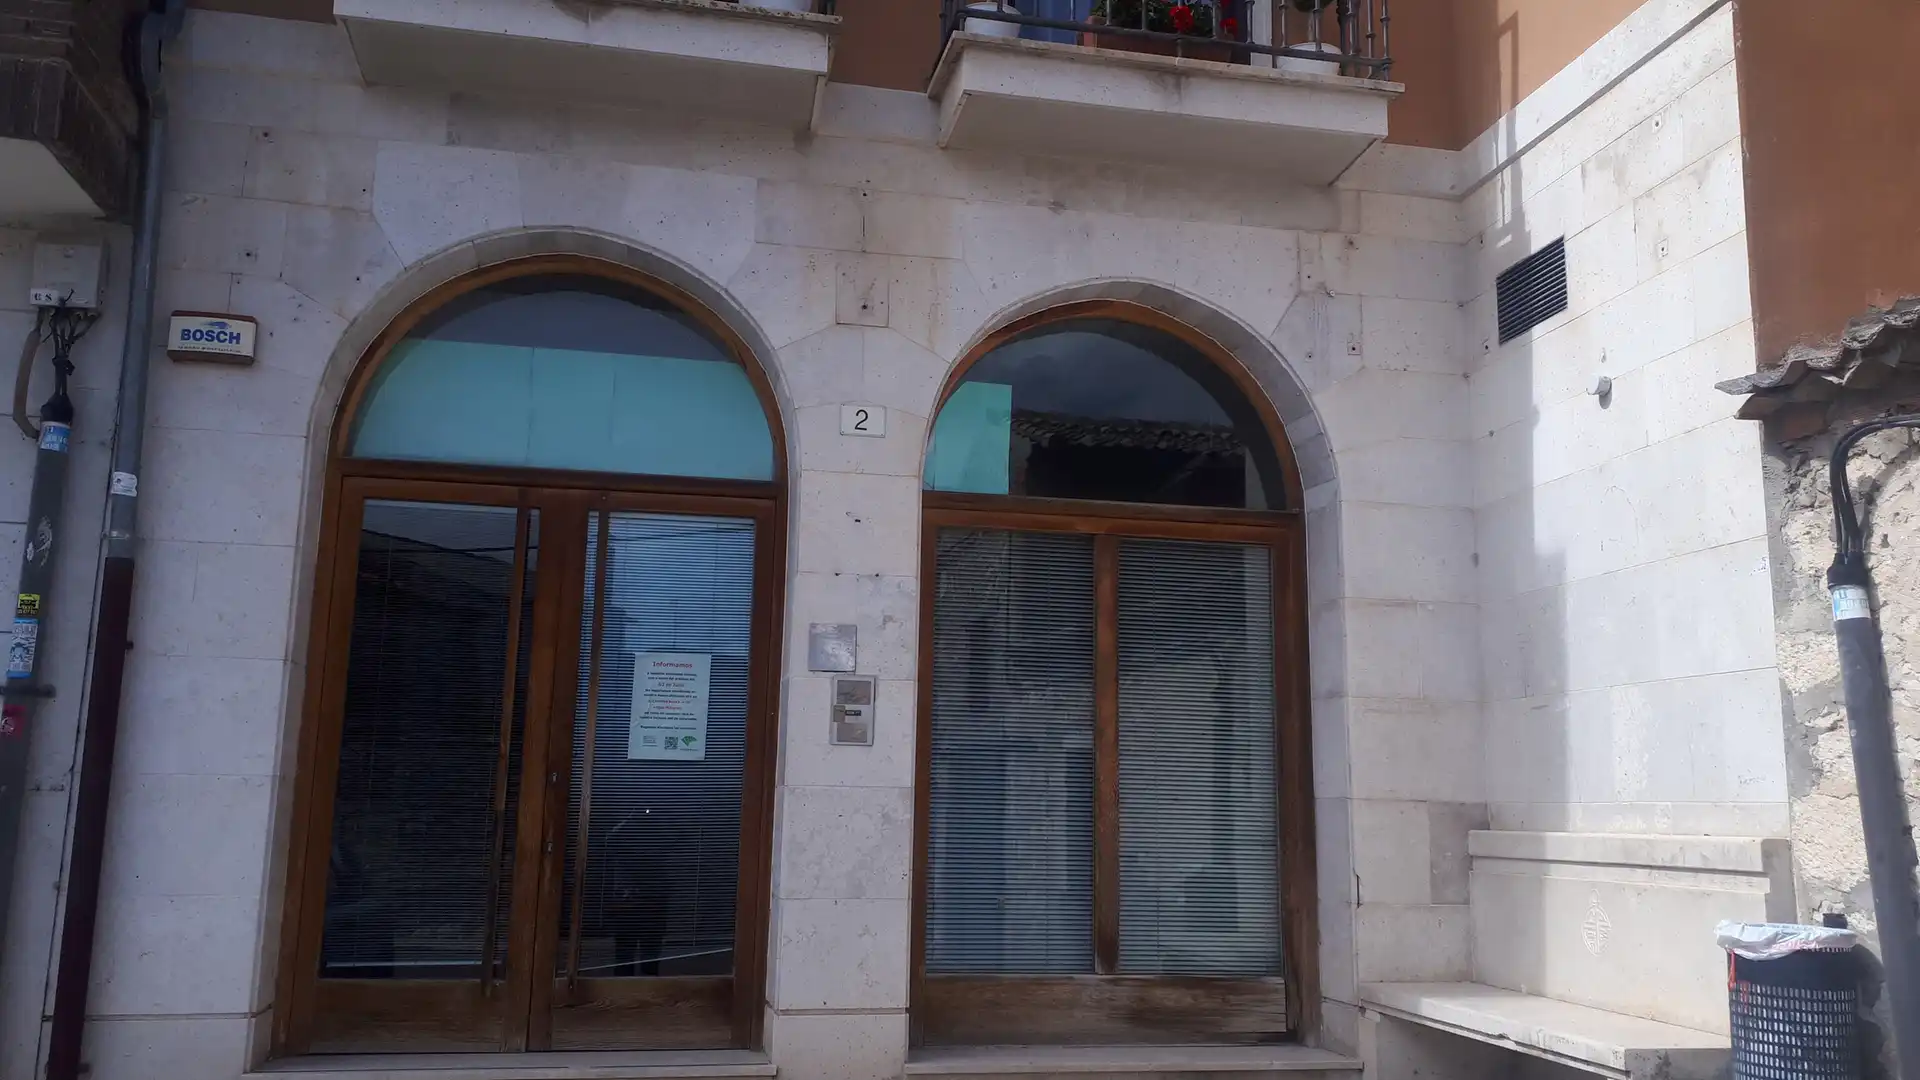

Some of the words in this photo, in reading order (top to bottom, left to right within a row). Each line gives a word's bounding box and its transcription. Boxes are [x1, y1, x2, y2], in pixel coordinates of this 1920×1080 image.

[180, 328, 241, 345] BOSCH
[854, 409, 869, 431] 2
[652, 661, 693, 669] Informamos
